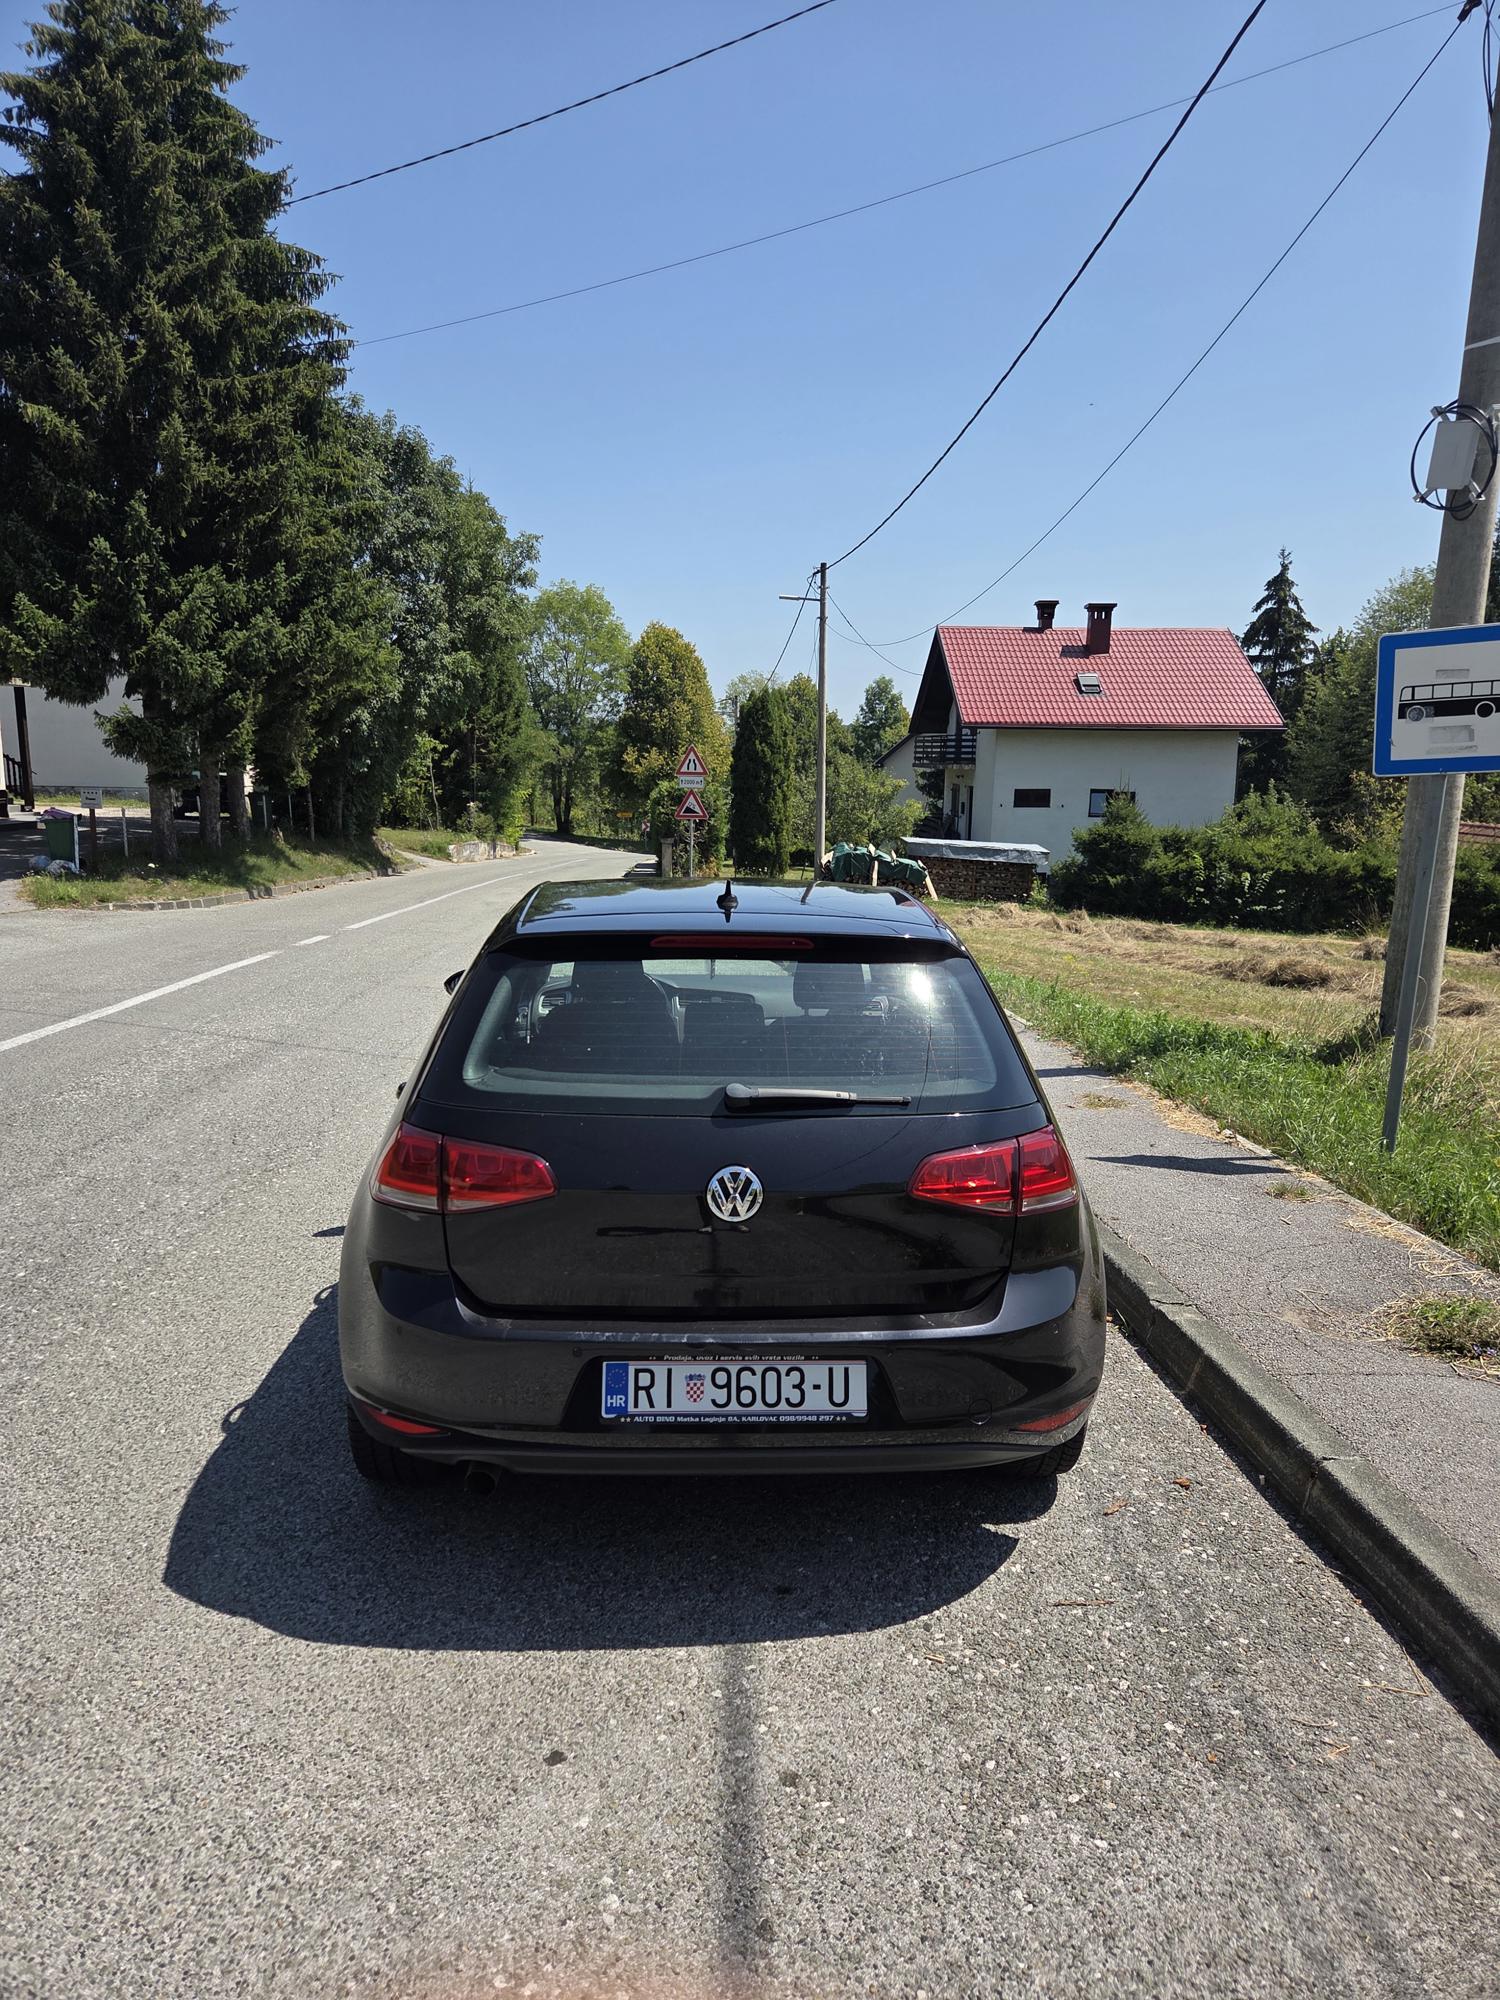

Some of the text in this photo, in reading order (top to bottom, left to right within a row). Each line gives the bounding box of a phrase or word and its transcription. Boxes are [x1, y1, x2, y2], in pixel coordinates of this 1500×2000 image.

[707, 1165, 763, 1222] VW
[607, 1395, 626, 1407] HR
[633, 1366, 850, 1408] RI 9603-U
